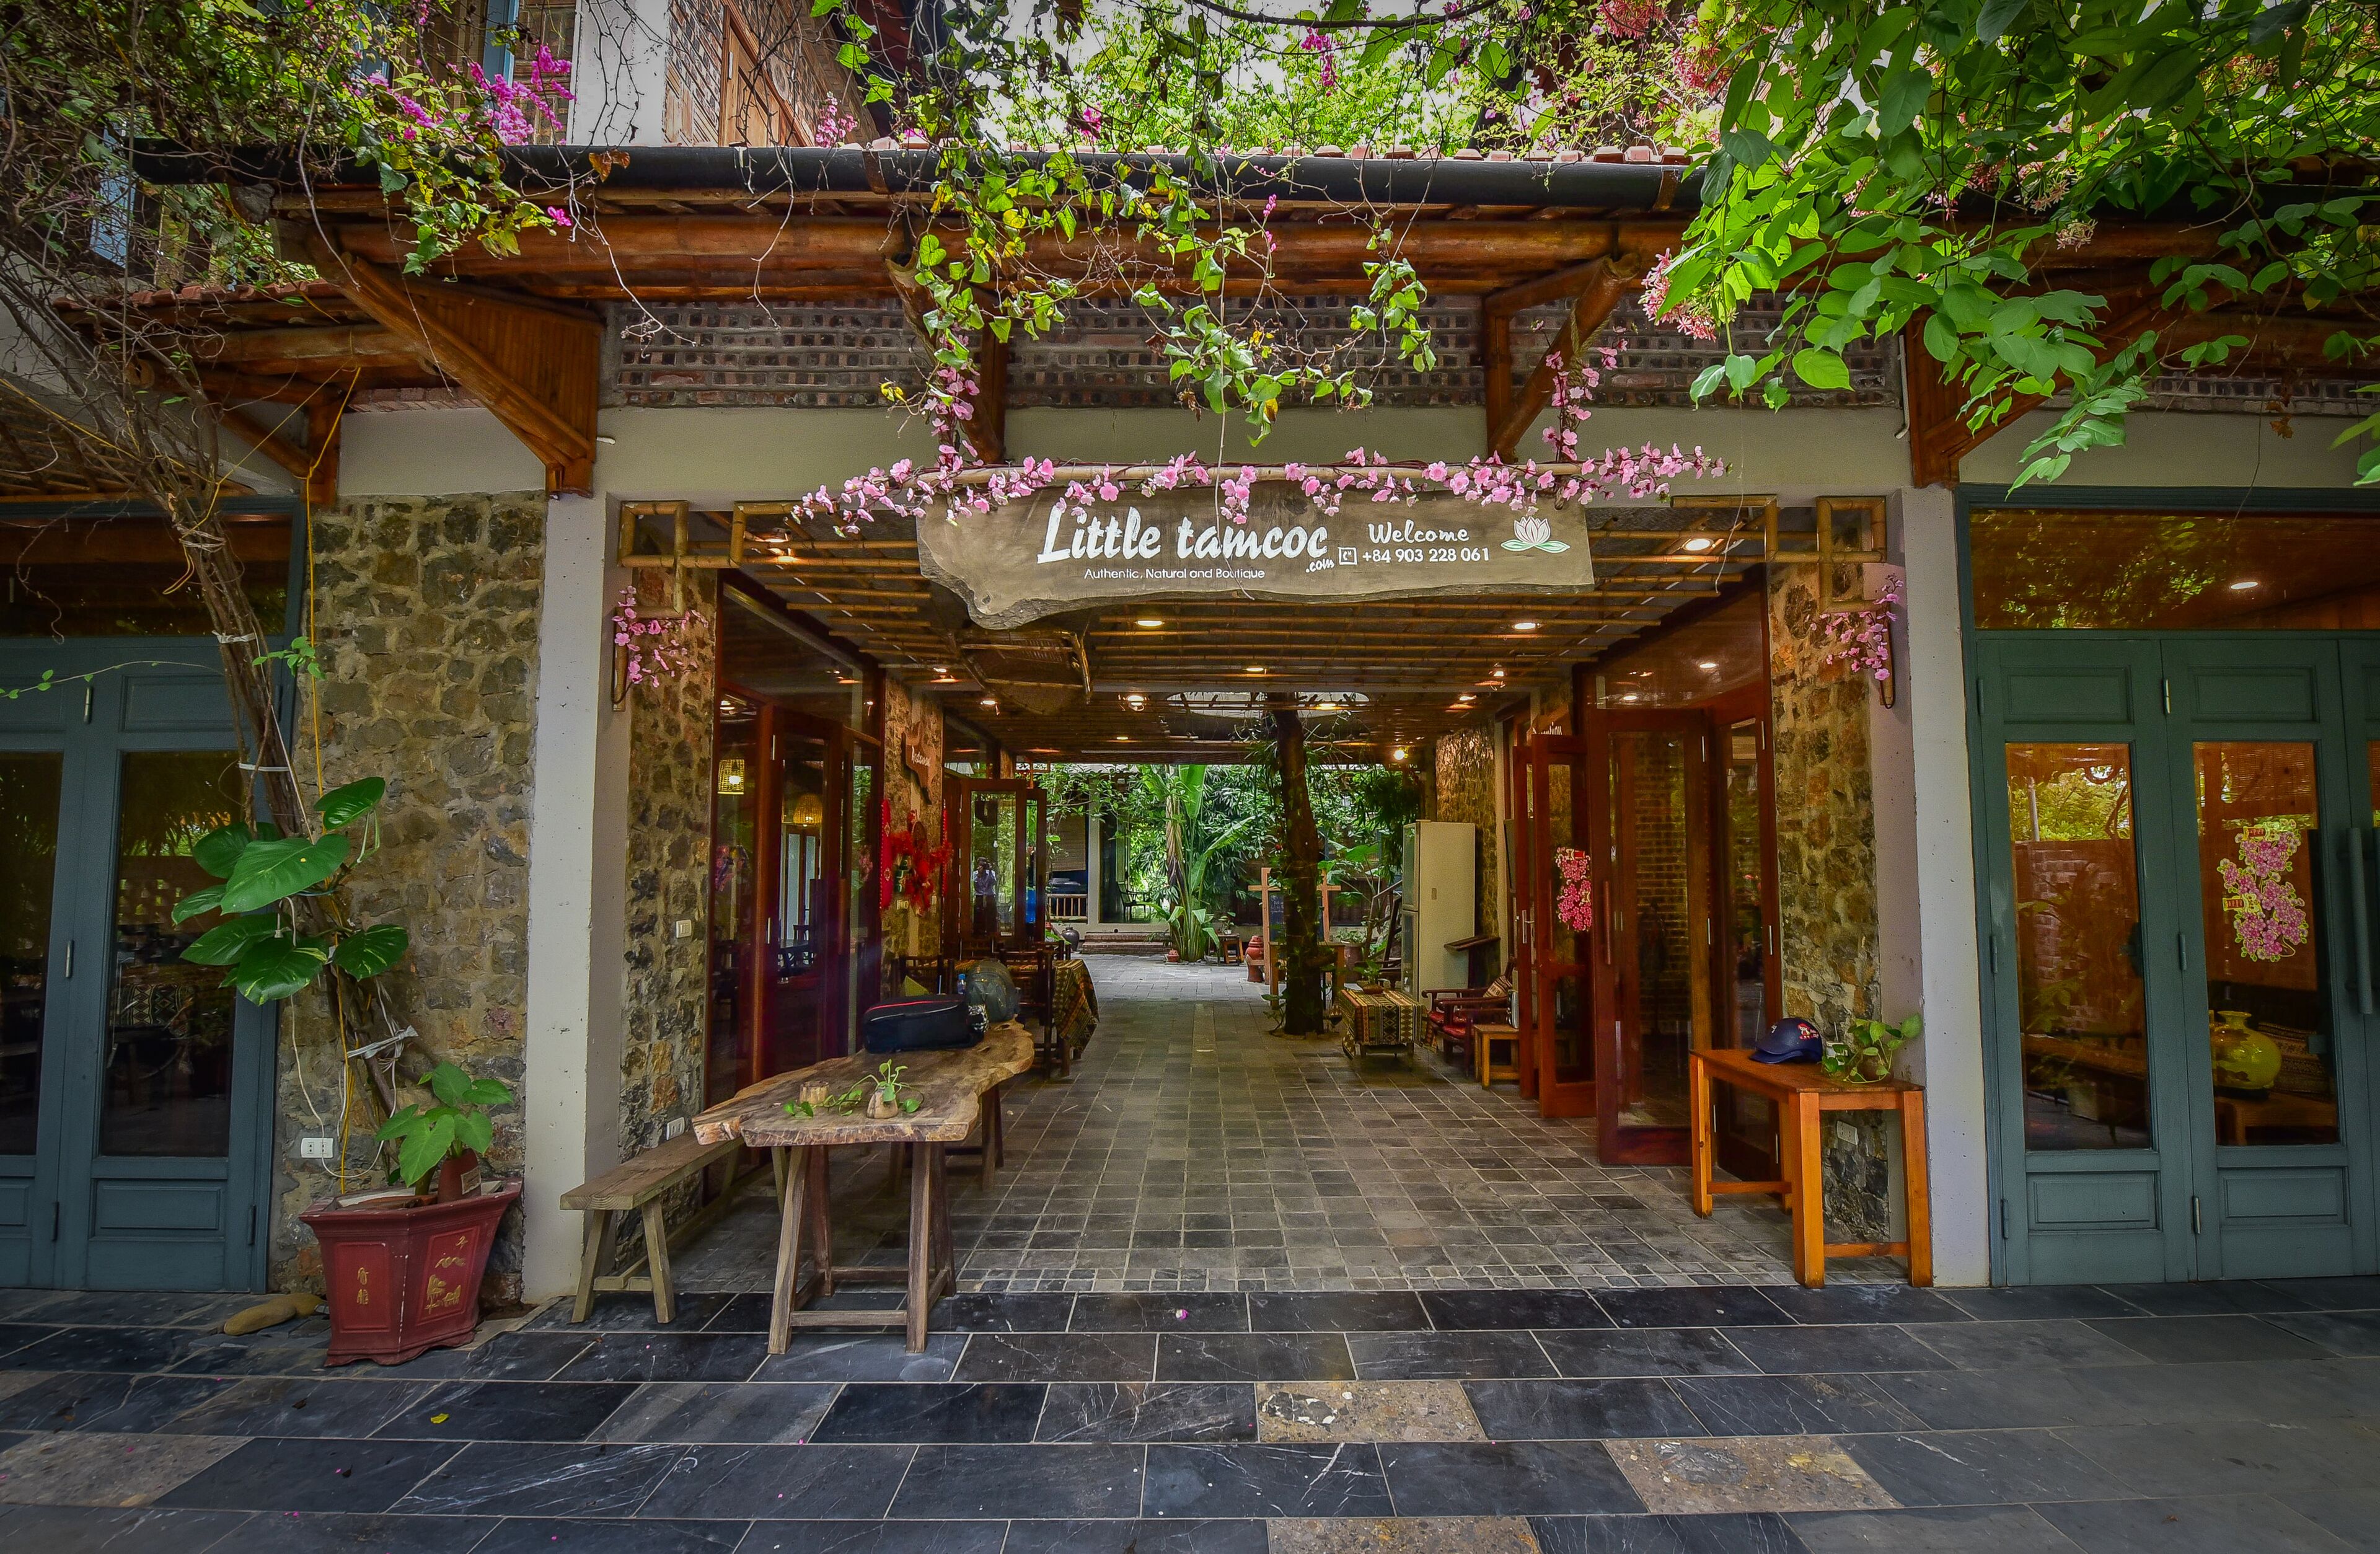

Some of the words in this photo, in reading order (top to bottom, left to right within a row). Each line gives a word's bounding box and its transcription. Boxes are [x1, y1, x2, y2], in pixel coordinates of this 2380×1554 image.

[1037, 505, 1161, 563] Little
[1177, 516, 1328, 559] tamcoc
[1368, 519, 1470, 544] Welcome
[1362, 549, 1391, 563] +84
[1395, 549, 1424, 562] 903
[1429, 548, 1457, 562] 228
[1460, 547, 1489, 561] 061
[1305, 558, 1334, 573] .com
[1084, 568, 1143, 579] Authentic,
[1146, 568, 1186, 578] Natural
[1189, 568, 1212, 578] and
[1216, 568, 1265, 580] Boutique
